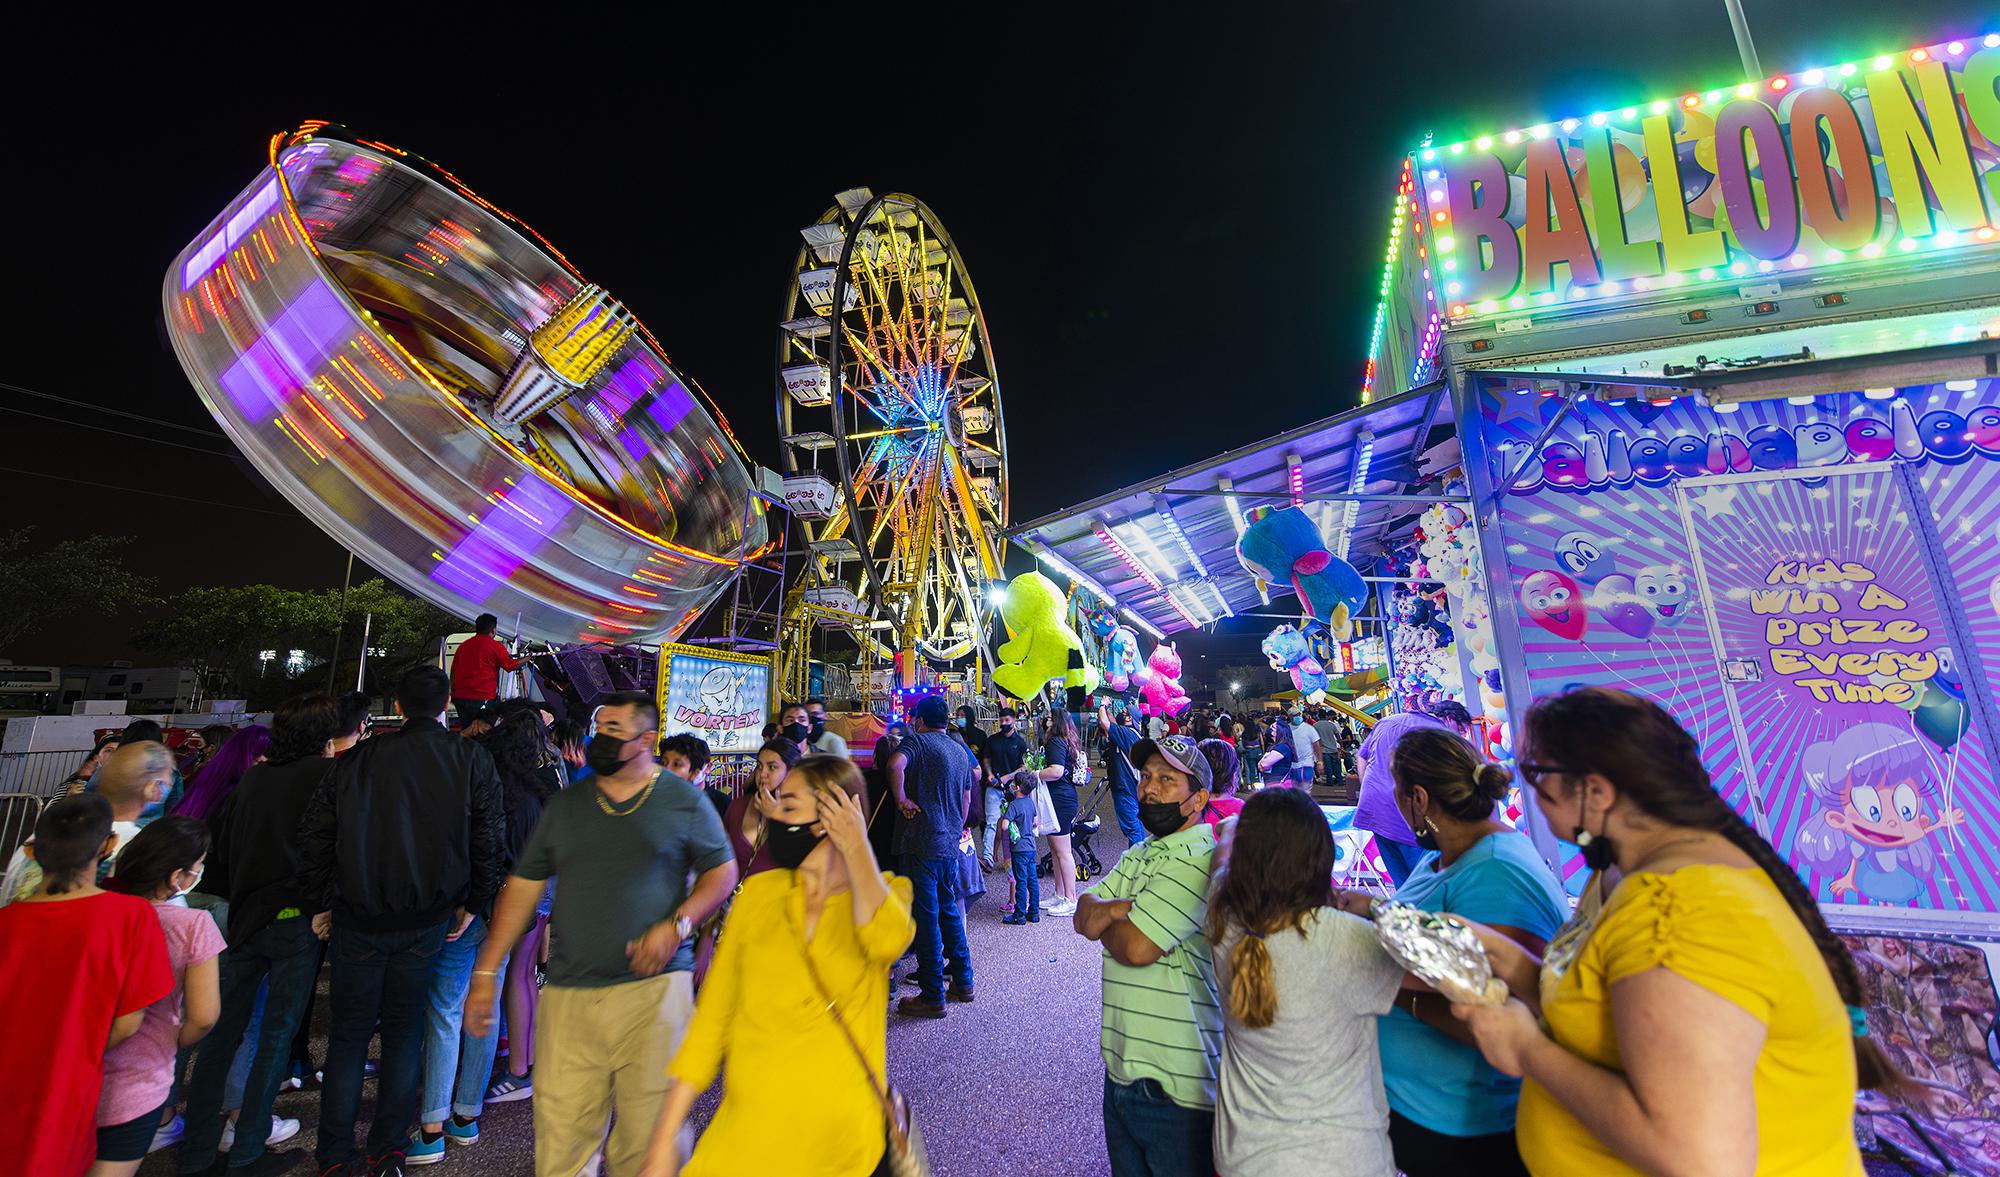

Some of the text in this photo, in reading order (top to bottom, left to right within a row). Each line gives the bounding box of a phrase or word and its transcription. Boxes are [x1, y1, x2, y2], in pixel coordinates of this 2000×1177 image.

[1765, 558, 1876, 585] Kids
[1750, 583, 1908, 615] Win A
[1765, 617, 1929, 646] Prize
[1768, 648, 1939, 681] Every
[1793, 678, 1915, 704] Time
[674, 704, 760, 730] VORTEX
